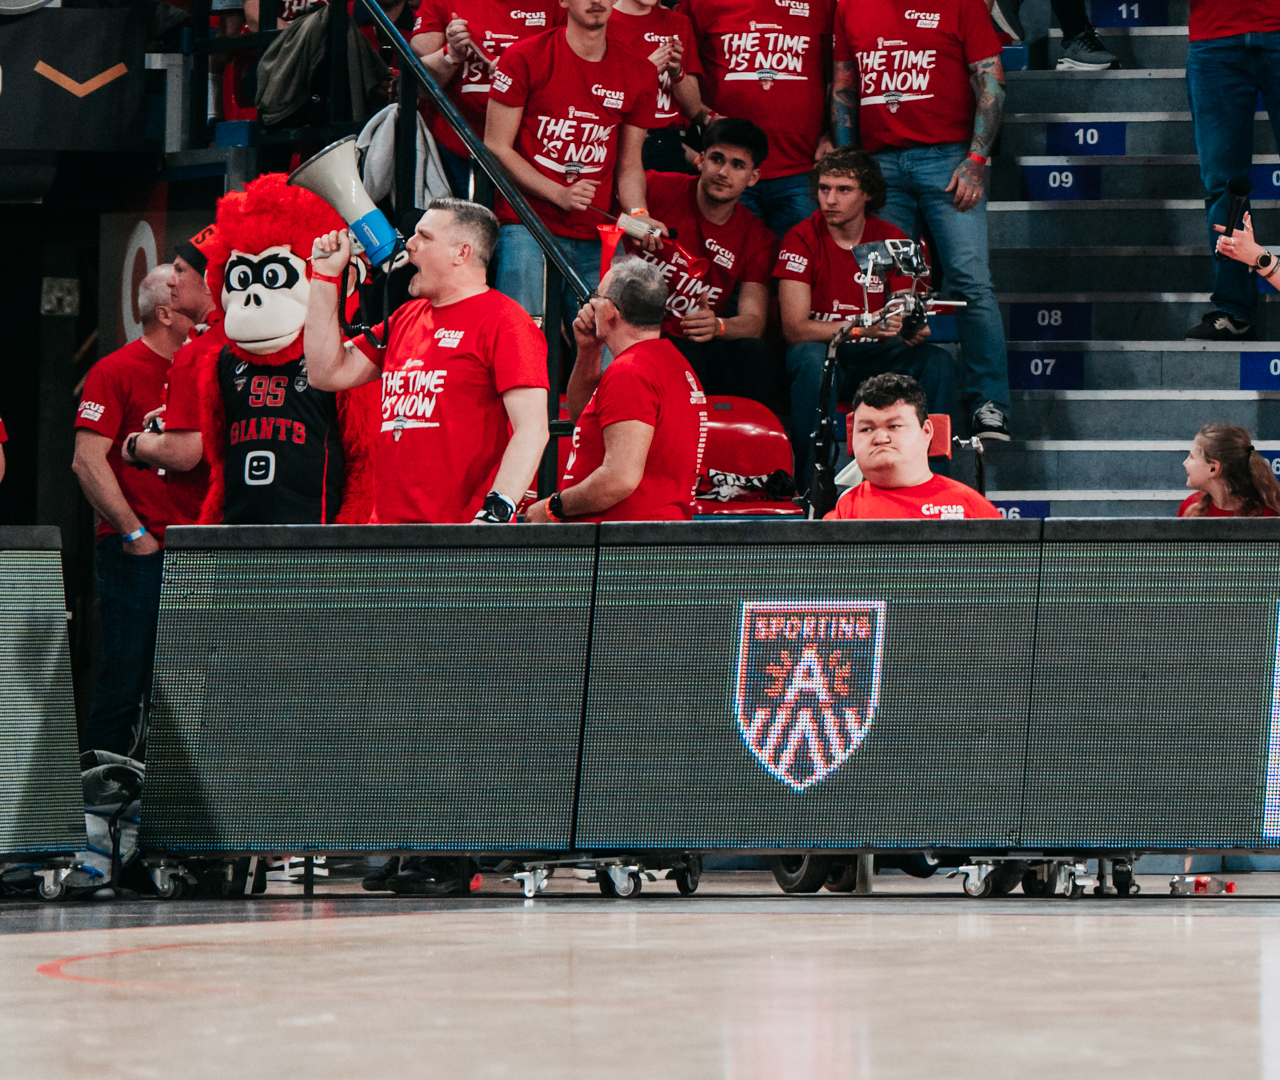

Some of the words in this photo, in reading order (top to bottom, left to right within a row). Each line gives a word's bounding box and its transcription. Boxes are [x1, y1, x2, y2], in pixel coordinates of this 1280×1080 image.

[510, 10, 546, 20] Circus
[788, 8, 810, 17] Daily
[905, 9, 940, 21] Circus
[1118, 3, 1140, 19] 11
[917, 19, 940, 28] Daily
[721, 33, 760, 56] THE
[765, 33, 810, 54] TIME
[729, 50, 750, 71] IS
[755, 52, 802, 72] NOW
[856, 51, 887, 72] THE
[891, 50, 936, 70] TIME
[861, 72, 877, 93] IS
[881, 69, 929, 90] NOW
[591, 84, 624, 101] Circus
[537, 116, 577, 140] THE
[1074, 128, 1099, 145] 10
[564, 142, 607, 162] NOW
[1048, 172, 1073, 188] 09
[1037, 310, 1062, 326] 08
[1030, 359, 1056, 375] 07
[382, 371, 406, 398] THE
[408, 370, 447, 394] TIME
[232, 417, 308, 445] GIANTS
[921, 504, 964, 516] Circus
[754, 615, 870, 639] SPORTING
